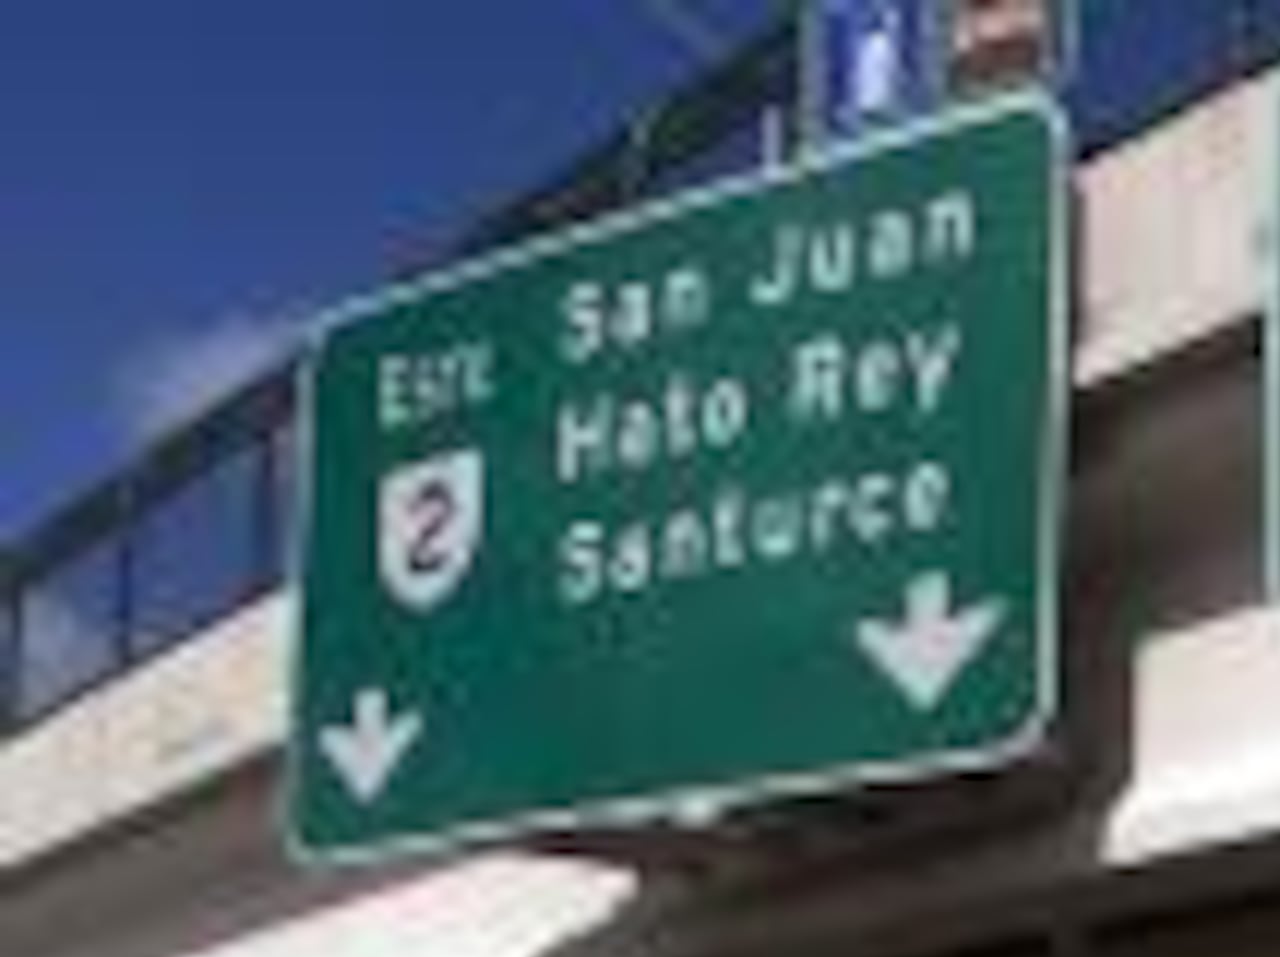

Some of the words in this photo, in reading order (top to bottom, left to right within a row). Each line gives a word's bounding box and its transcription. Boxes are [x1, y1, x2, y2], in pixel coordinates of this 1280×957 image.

[559, 270, 707, 360] San
[753, 192, 974, 306] Juan
[557, 377, 747, 480] Hato
[797, 324, 959, 416] Rey
[405, 482, 456, 574] 2
[557, 461, 948, 599] Santurce
